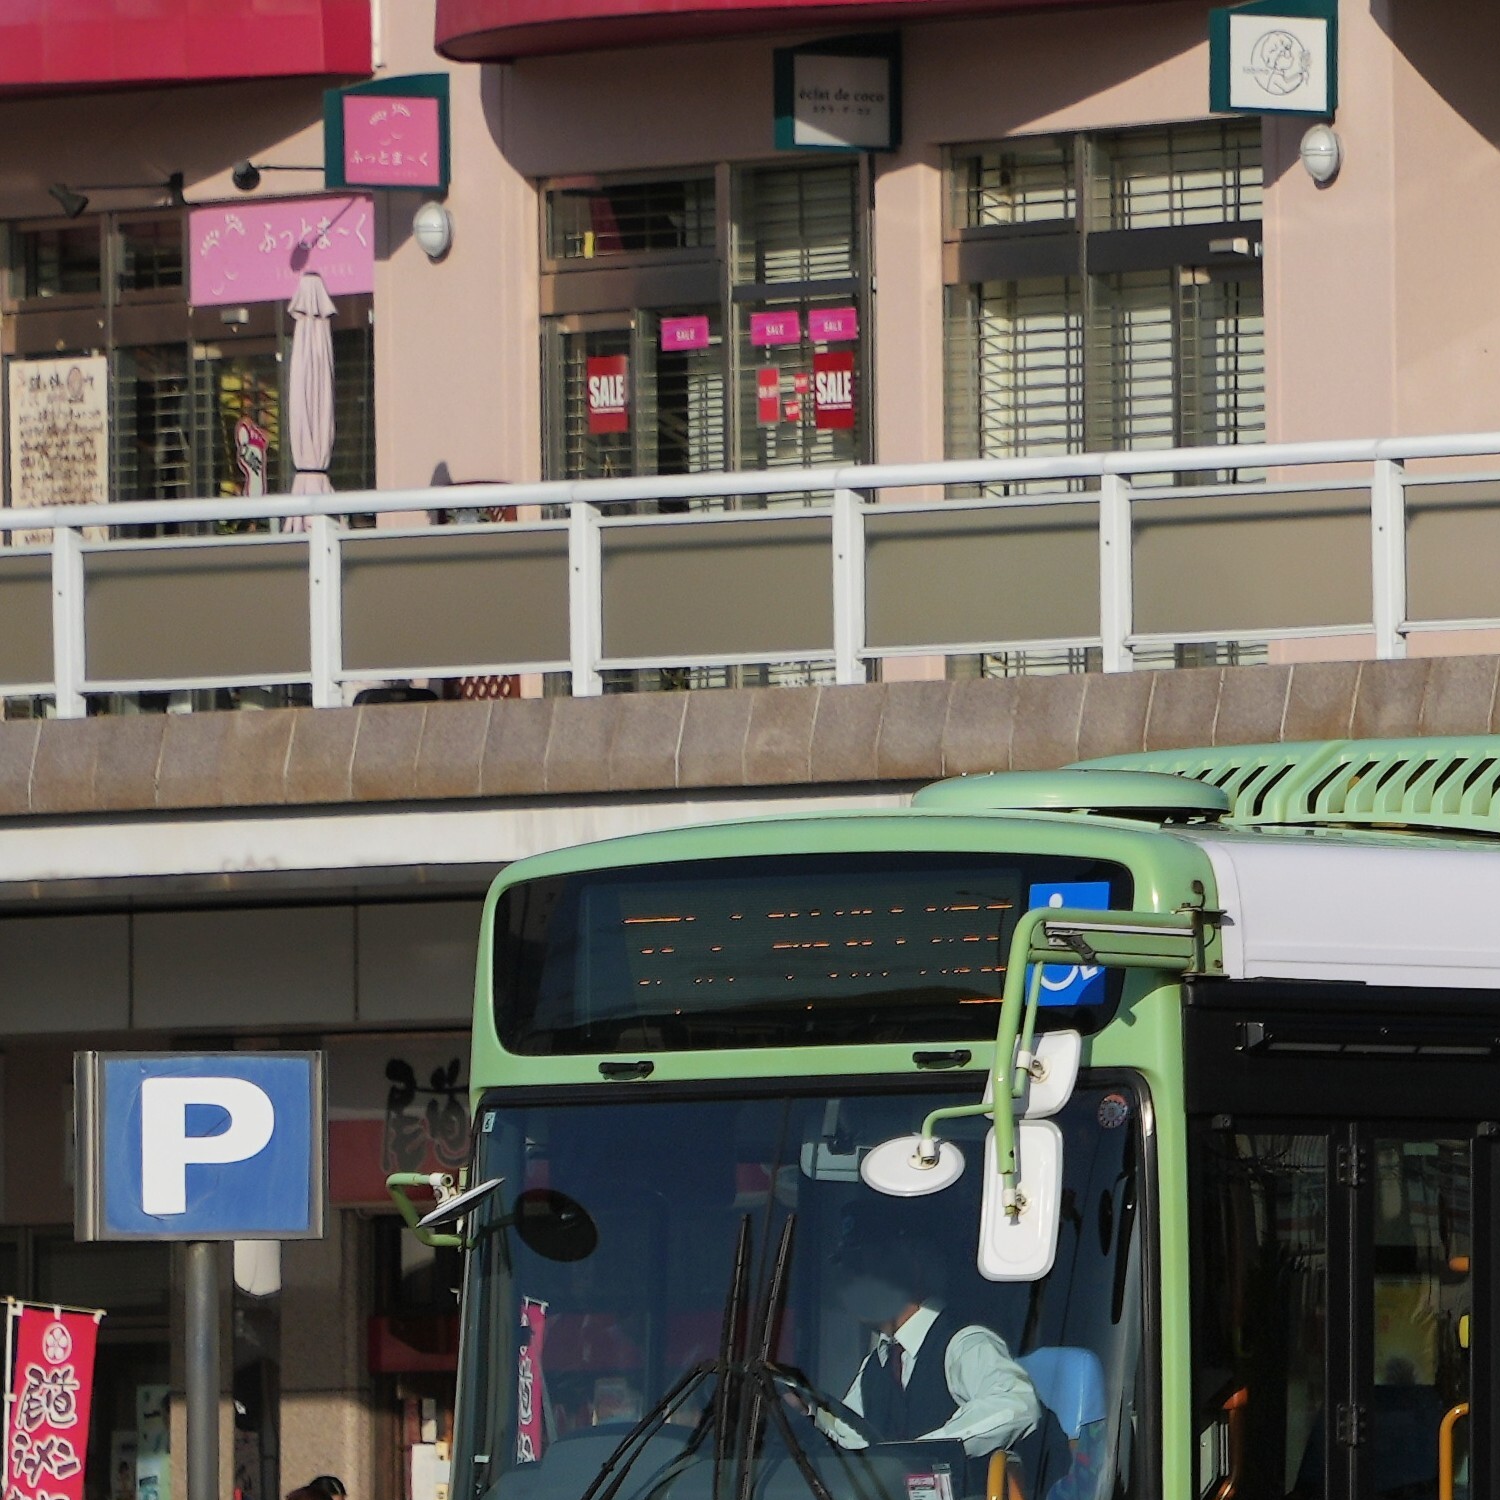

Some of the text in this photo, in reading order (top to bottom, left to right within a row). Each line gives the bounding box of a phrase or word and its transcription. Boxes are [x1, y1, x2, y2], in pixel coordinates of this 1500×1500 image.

[675, 328, 696, 342] SALE
[765, 323, 785, 337] SALE
[823, 319, 844, 333] SALE
[588, 374, 626, 409] SALE
[815, 370, 852, 405] SALE
[142, 1077, 275, 1215] P
